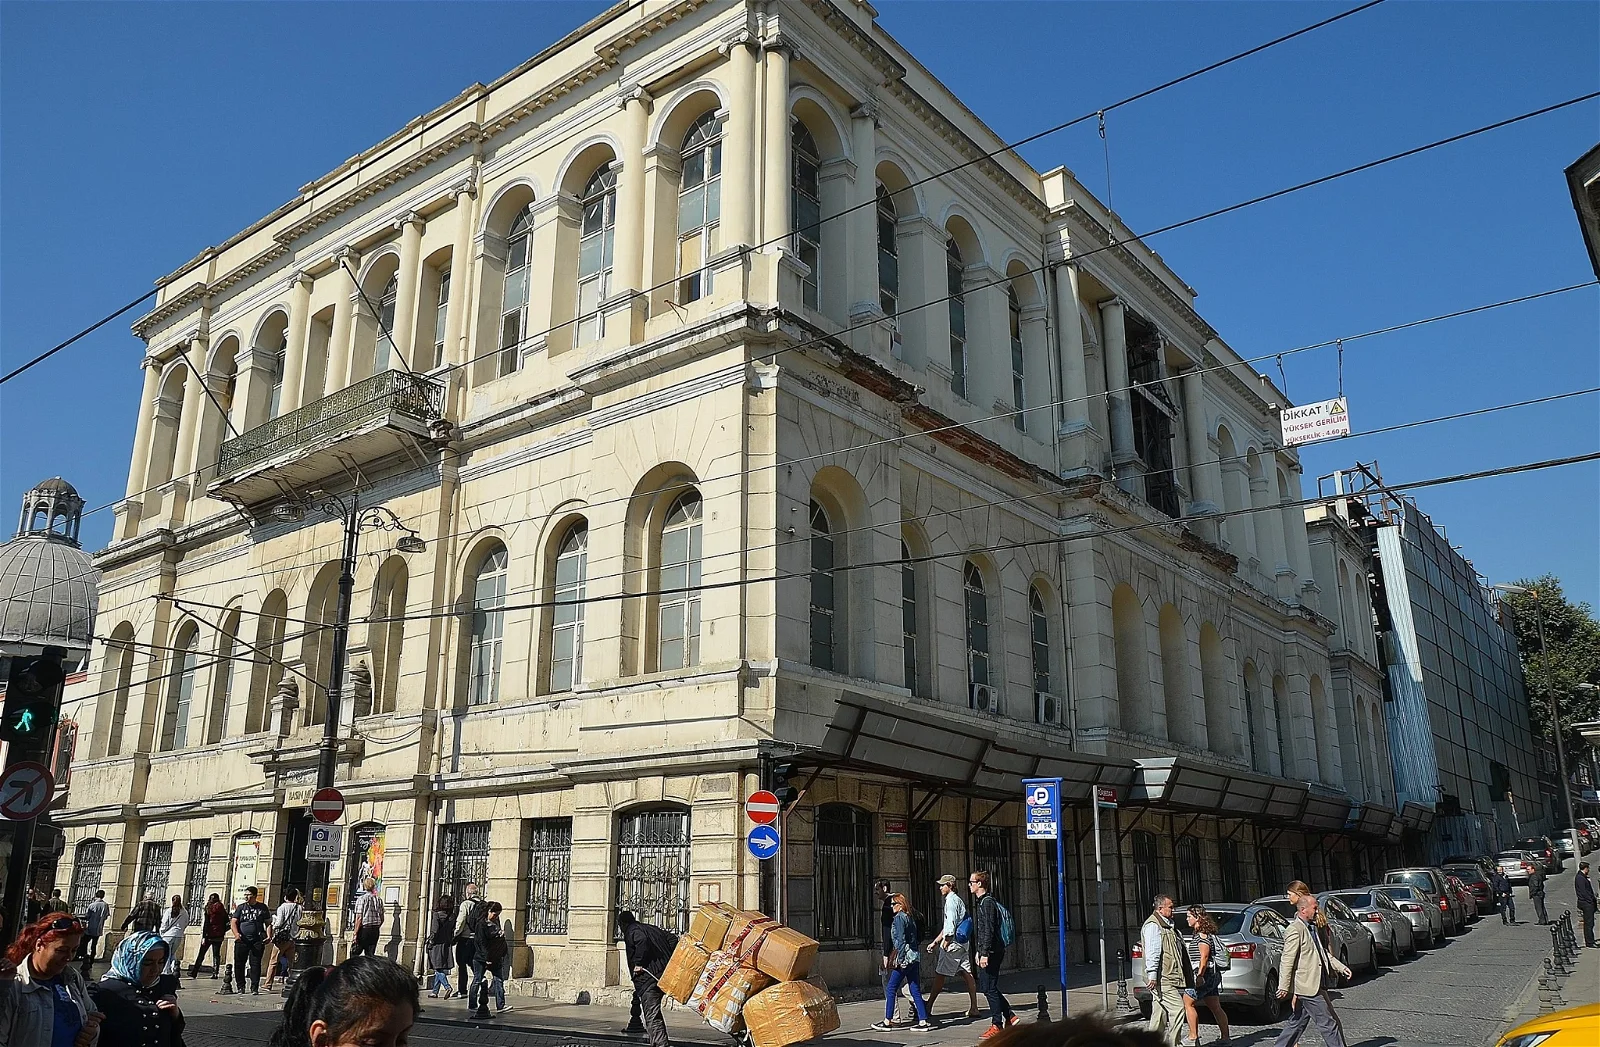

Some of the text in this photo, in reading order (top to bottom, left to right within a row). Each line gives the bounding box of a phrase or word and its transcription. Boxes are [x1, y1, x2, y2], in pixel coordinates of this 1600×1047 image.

[1283, 406, 1322, 422] DİKKAT
[1283, 415, 1347, 433] YÜKSEK GERİLİM
